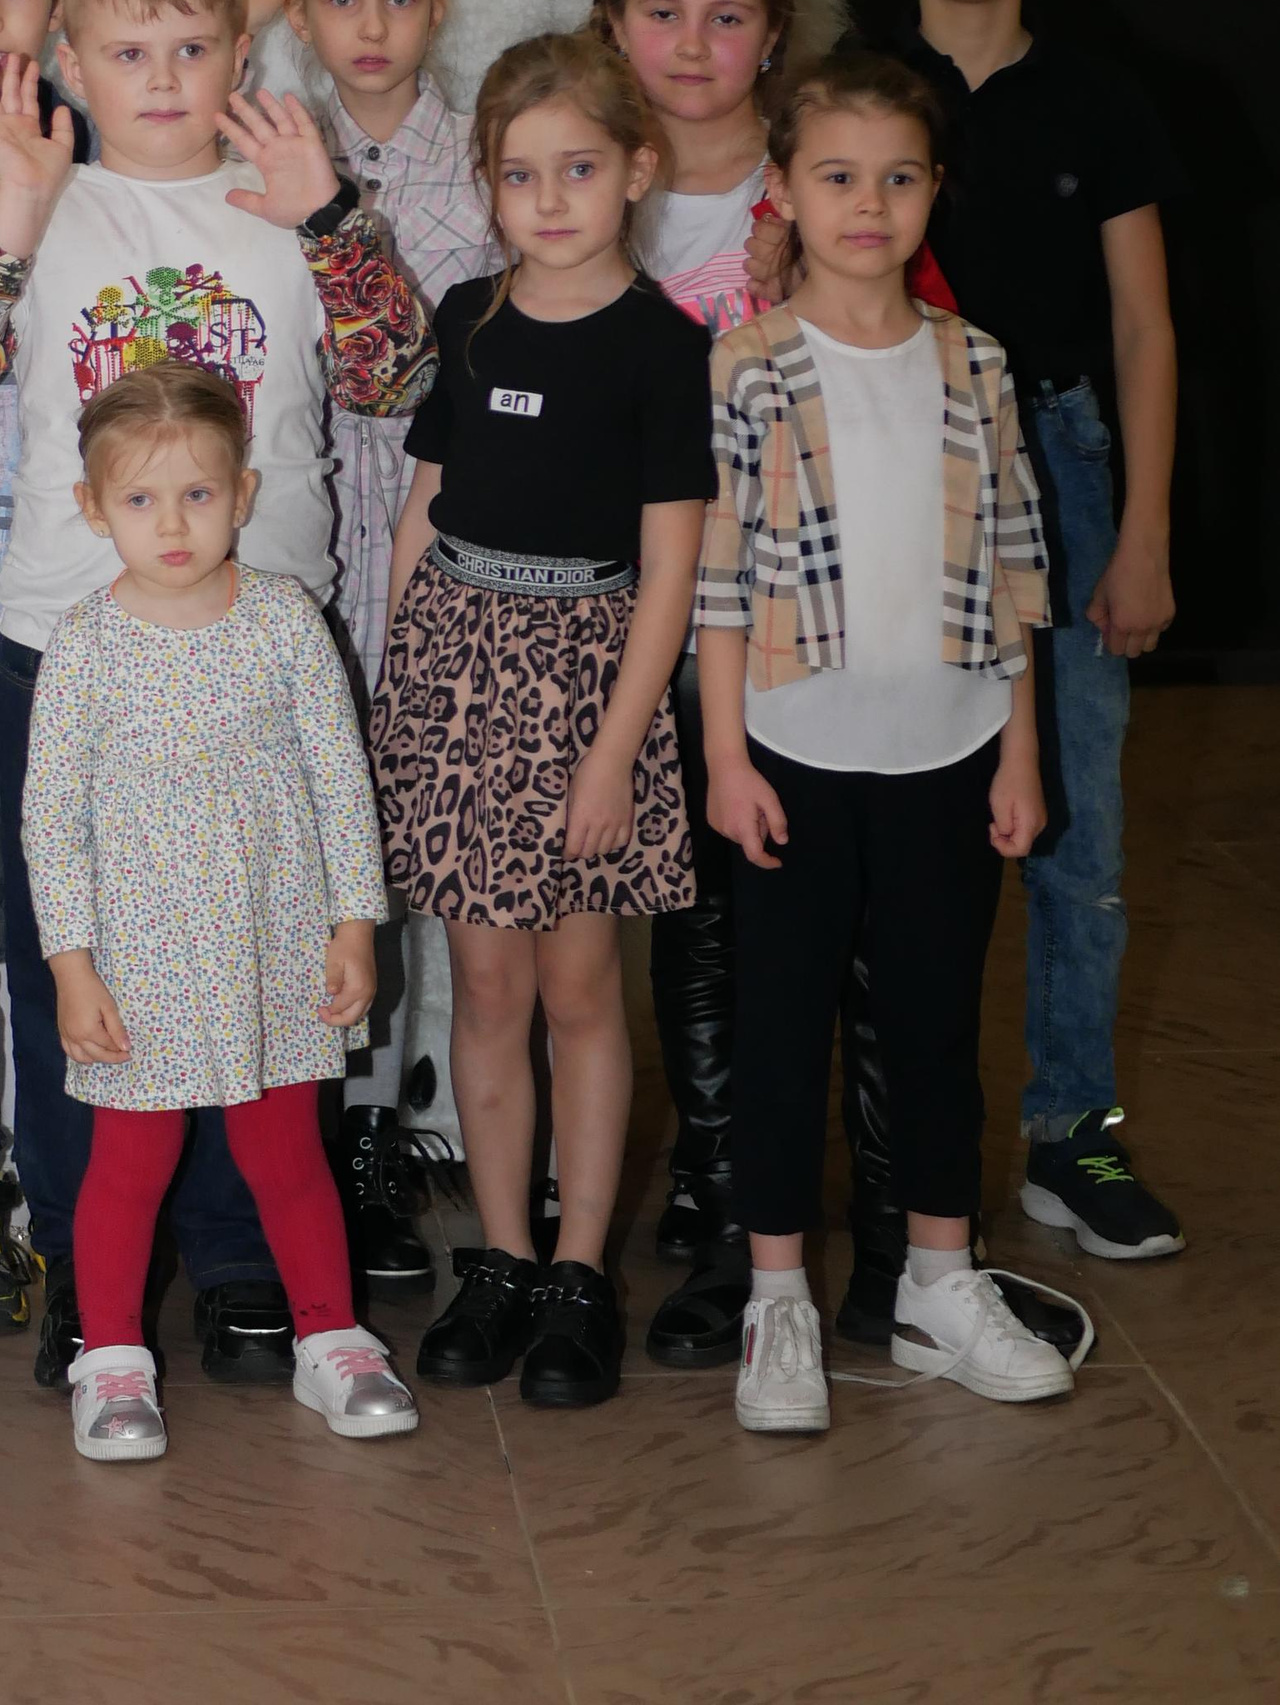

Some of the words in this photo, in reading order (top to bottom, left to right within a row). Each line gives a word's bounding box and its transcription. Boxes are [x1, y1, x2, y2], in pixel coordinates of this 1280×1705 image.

[500, 392, 528, 413] an
[457, 553, 548, 583] CHRISTIAN
[553, 569, 596, 584] DIOR
